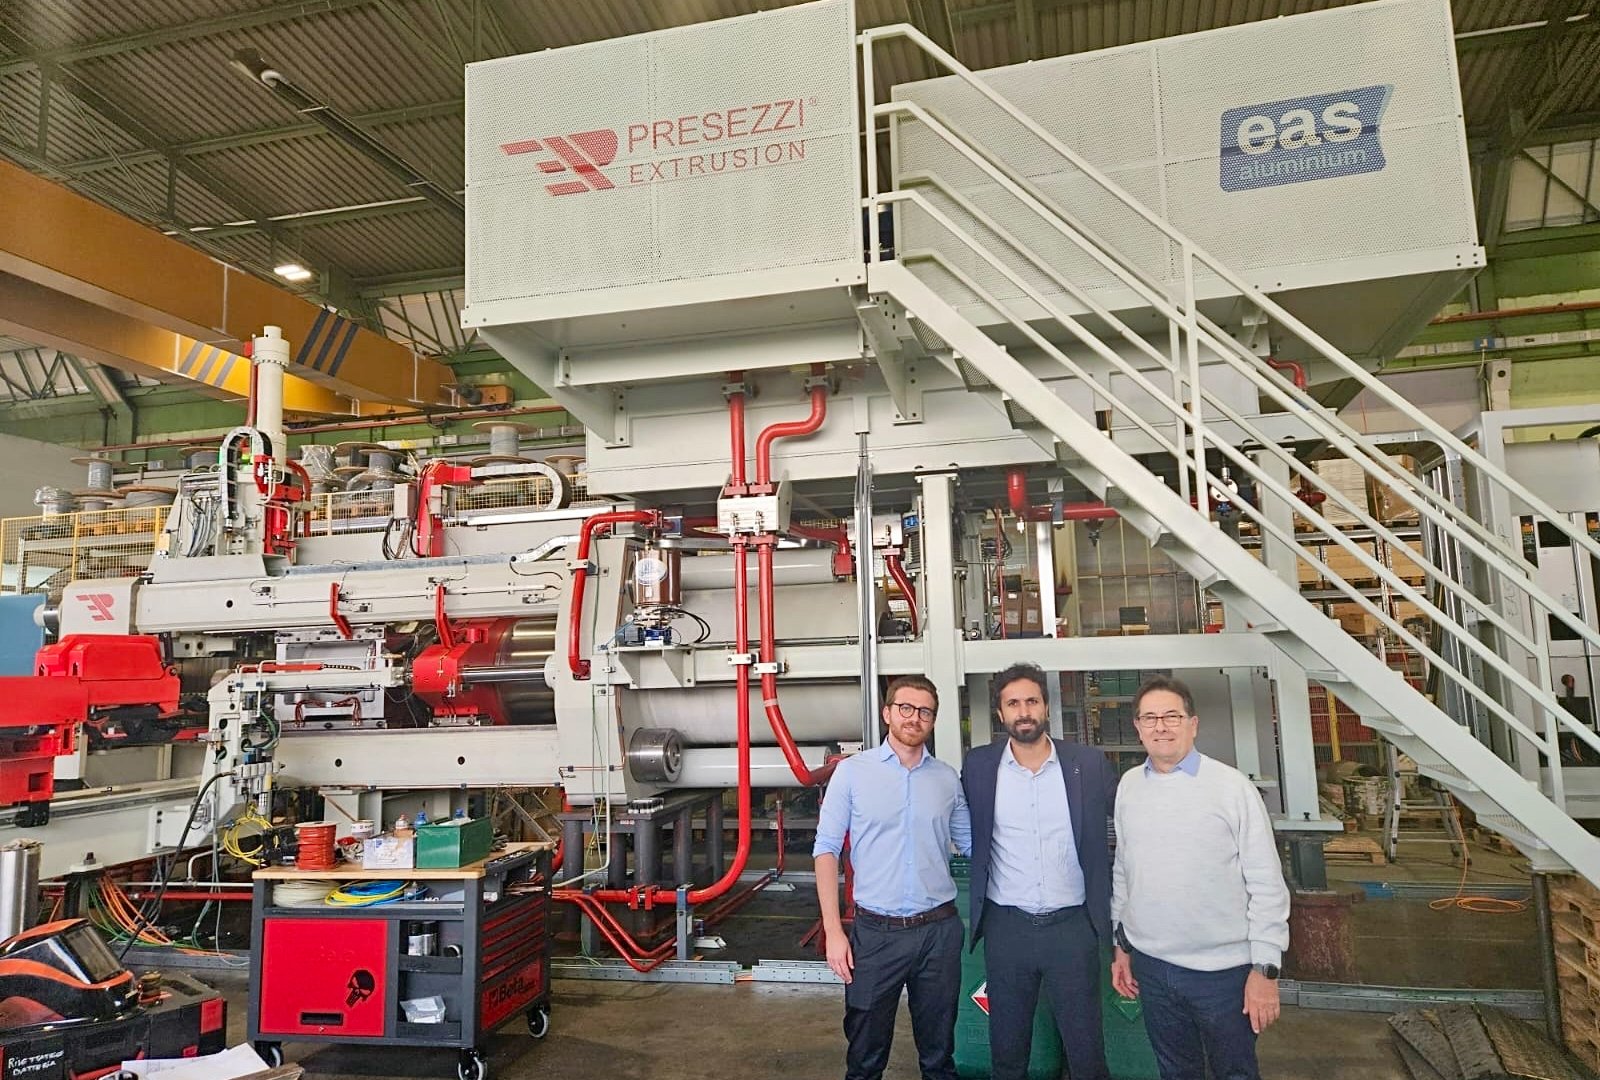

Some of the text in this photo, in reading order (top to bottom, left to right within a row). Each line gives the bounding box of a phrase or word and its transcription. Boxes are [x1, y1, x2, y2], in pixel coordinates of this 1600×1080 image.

[627, 98, 804, 153] PRESEZZI
[1237, 100, 1363, 156] eas
[629, 139, 806, 184] EXTRUSION
[1239, 149, 1366, 181] aluminium
